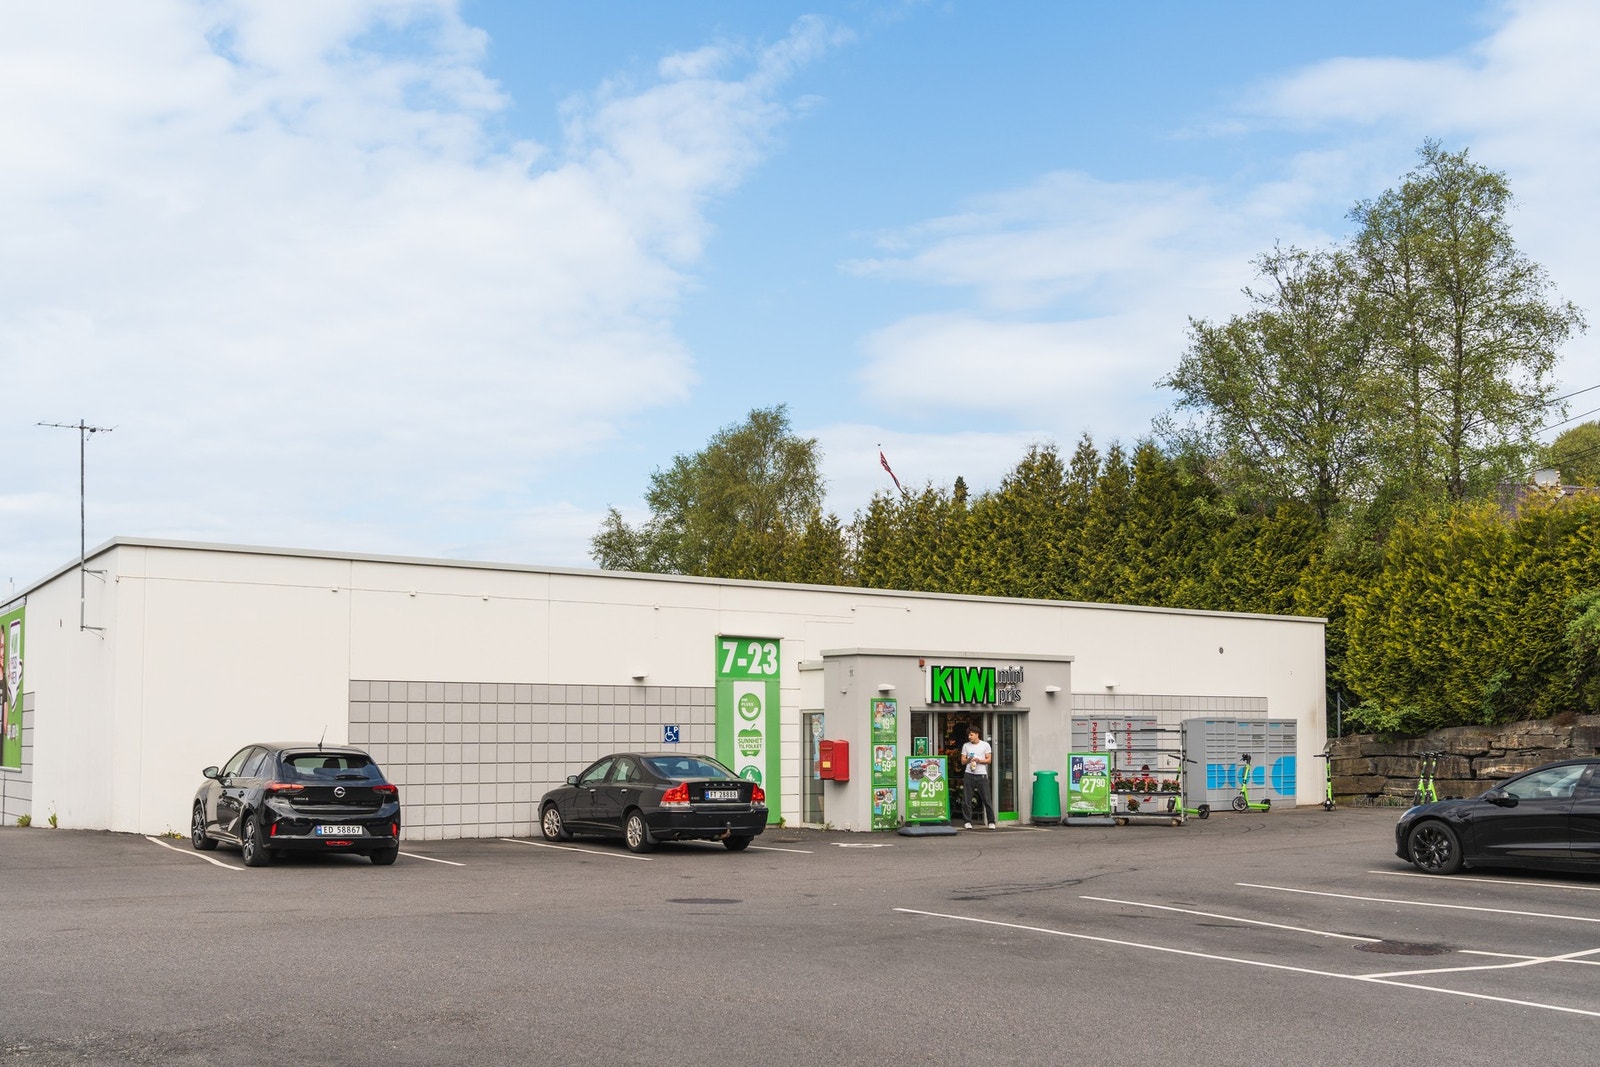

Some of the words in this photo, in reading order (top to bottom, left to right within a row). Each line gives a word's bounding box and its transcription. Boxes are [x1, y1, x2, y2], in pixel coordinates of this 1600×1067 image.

[722, 642, 778, 675] 7-23
[931, 665, 996, 704] KIWI
[997, 666, 1023, 683] mini
[998, 685, 1021, 706] pris
[323, 826, 334, 834] ED
[337, 826, 361, 834] 58867
